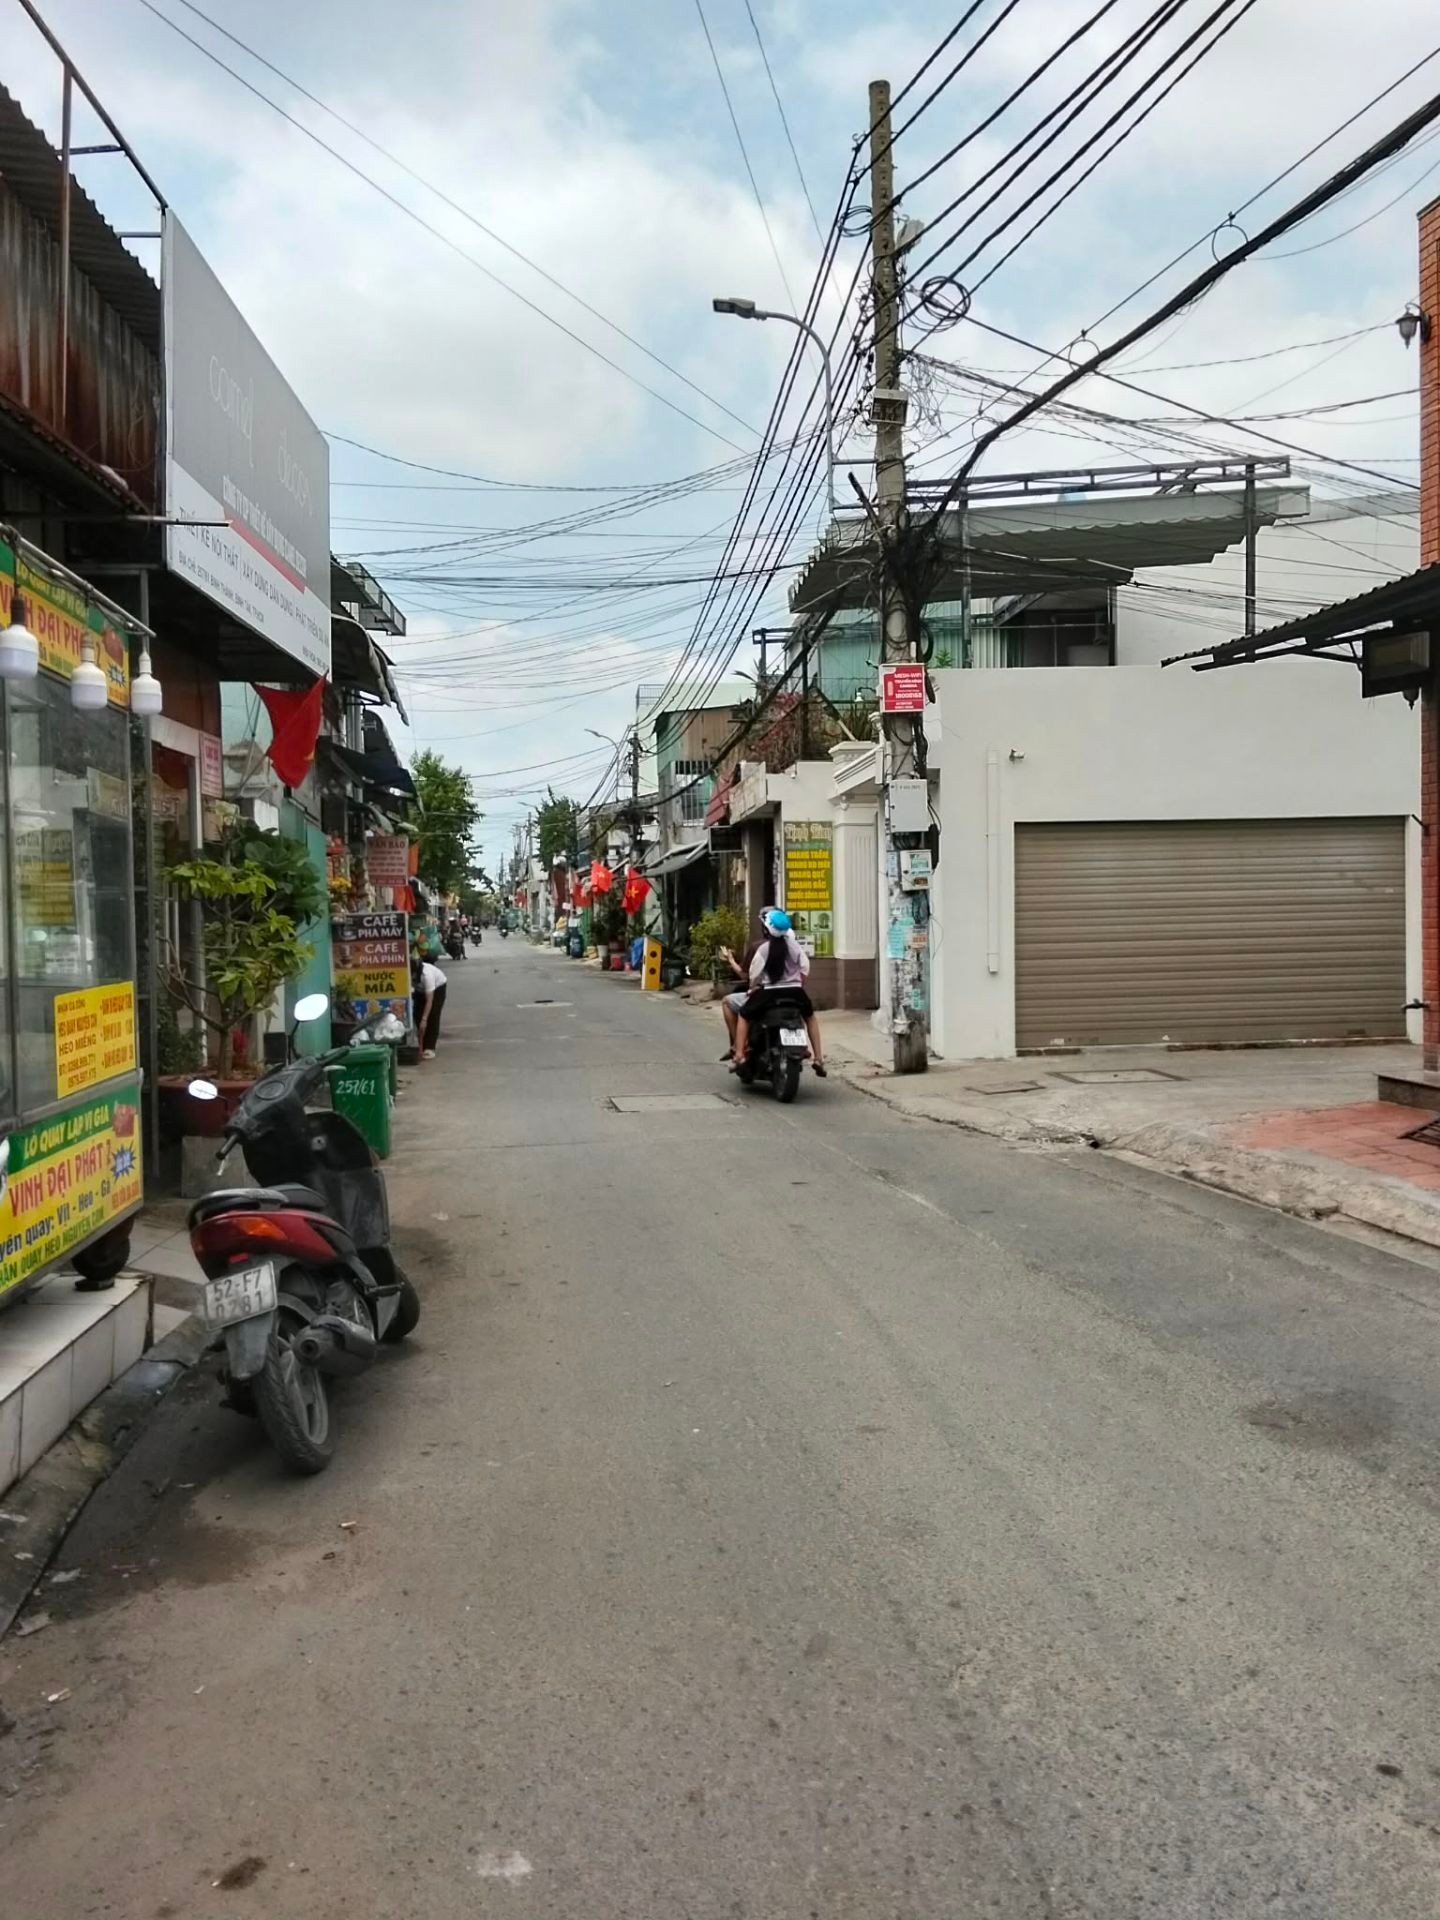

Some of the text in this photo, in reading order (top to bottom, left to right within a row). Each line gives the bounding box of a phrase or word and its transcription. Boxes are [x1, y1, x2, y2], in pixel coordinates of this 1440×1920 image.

[358, 928, 379, 938] PHA
[360, 954, 405, 965] PHA PHIN
[59, 1041, 73, 1056] HEO
[336, 1078, 376, 1096] 257/61
[40, 1121, 66, 1153] QUAY
[47, 1157, 72, 1197] ĐẠI
[75, 1140, 104, 1183] PHÁT
[213, 1268, 262, 1303] 52-F7
